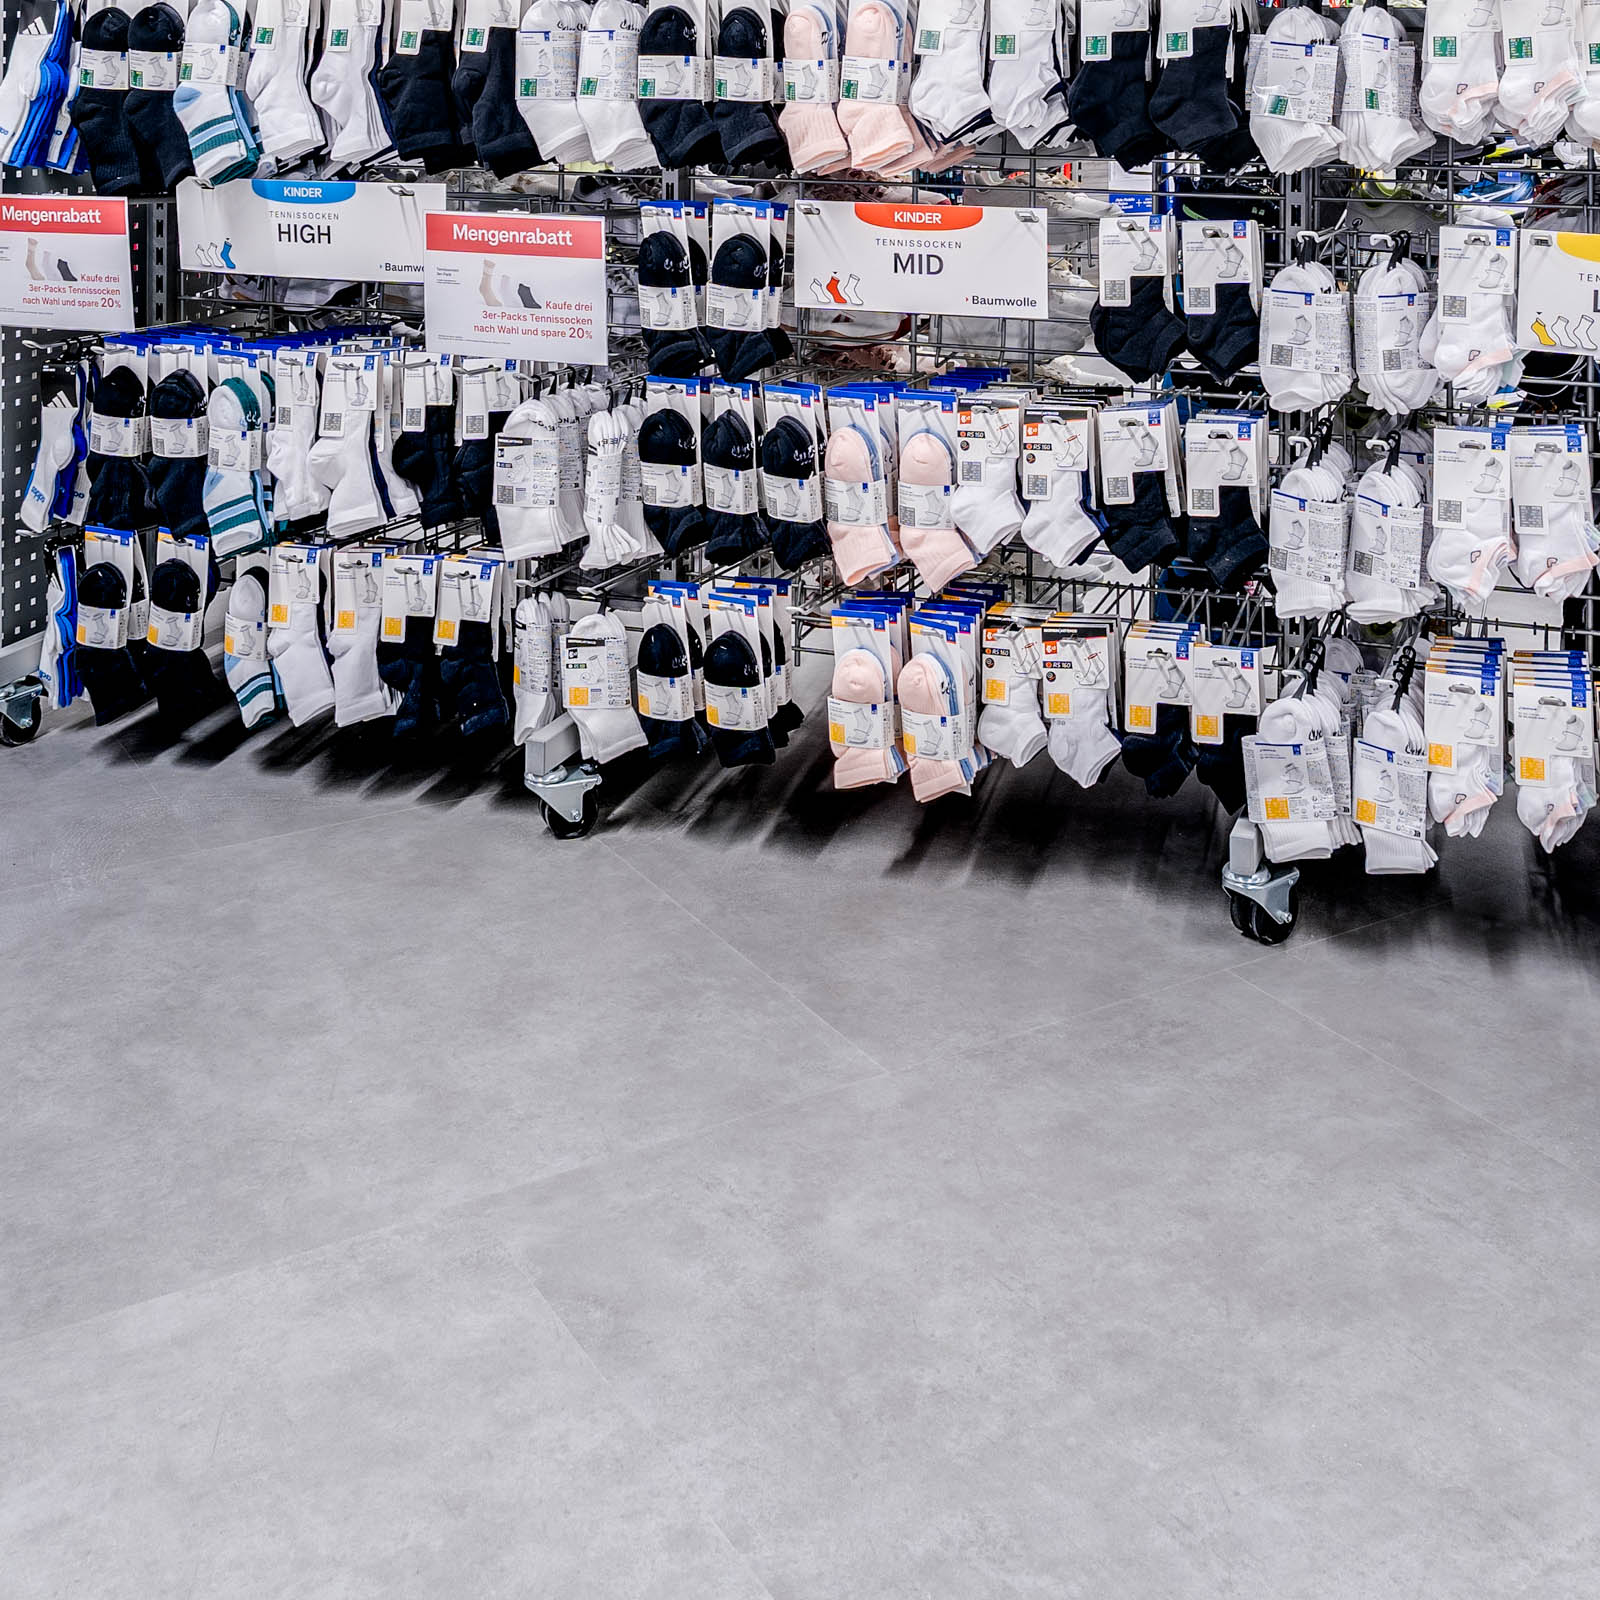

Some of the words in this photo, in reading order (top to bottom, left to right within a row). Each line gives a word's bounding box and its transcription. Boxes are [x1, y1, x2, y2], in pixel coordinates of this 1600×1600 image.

[283, 186, 323, 198] KINDER
[2, 205, 101, 226] Mengenrabatt
[269, 210, 340, 221] TENNISSOCKEN
[894, 211, 942, 224] KINDER
[277, 223, 332, 245] HIGH
[453, 223, 573, 247] Mengenrabatt
[875, 238, 962, 249] TENNISSOCKEN
[385, 261, 425, 273] Baumwo
[893, 252, 944, 275] MID
[80, 273, 104, 283] Kaufe
[106, 274, 120, 284] drei
[28, 284, 67, 294] 3er-Packs
[68, 286, 121, 296] Tennissocken
[22, 296, 40, 305] nach
[41, 297, 60, 306] Wahl
[62, 298, 76, 307] und
[77, 299, 99, 309] spare
[101, 297, 121, 308] 20%
[545, 300, 573, 311] Kaufe
[574, 301, 593, 311] drei
[972, 294, 1037, 308] Baumwolle
[482, 310, 527, 322] 3er-Packs
[530, 313, 593, 326] Tennissocken
[473, 323, 496, 333] nach
[497, 324, 519, 335] Wahl
[521, 326, 538, 336] und
[541, 329, 566, 340] spare
[569, 326, 593, 339] 20%
